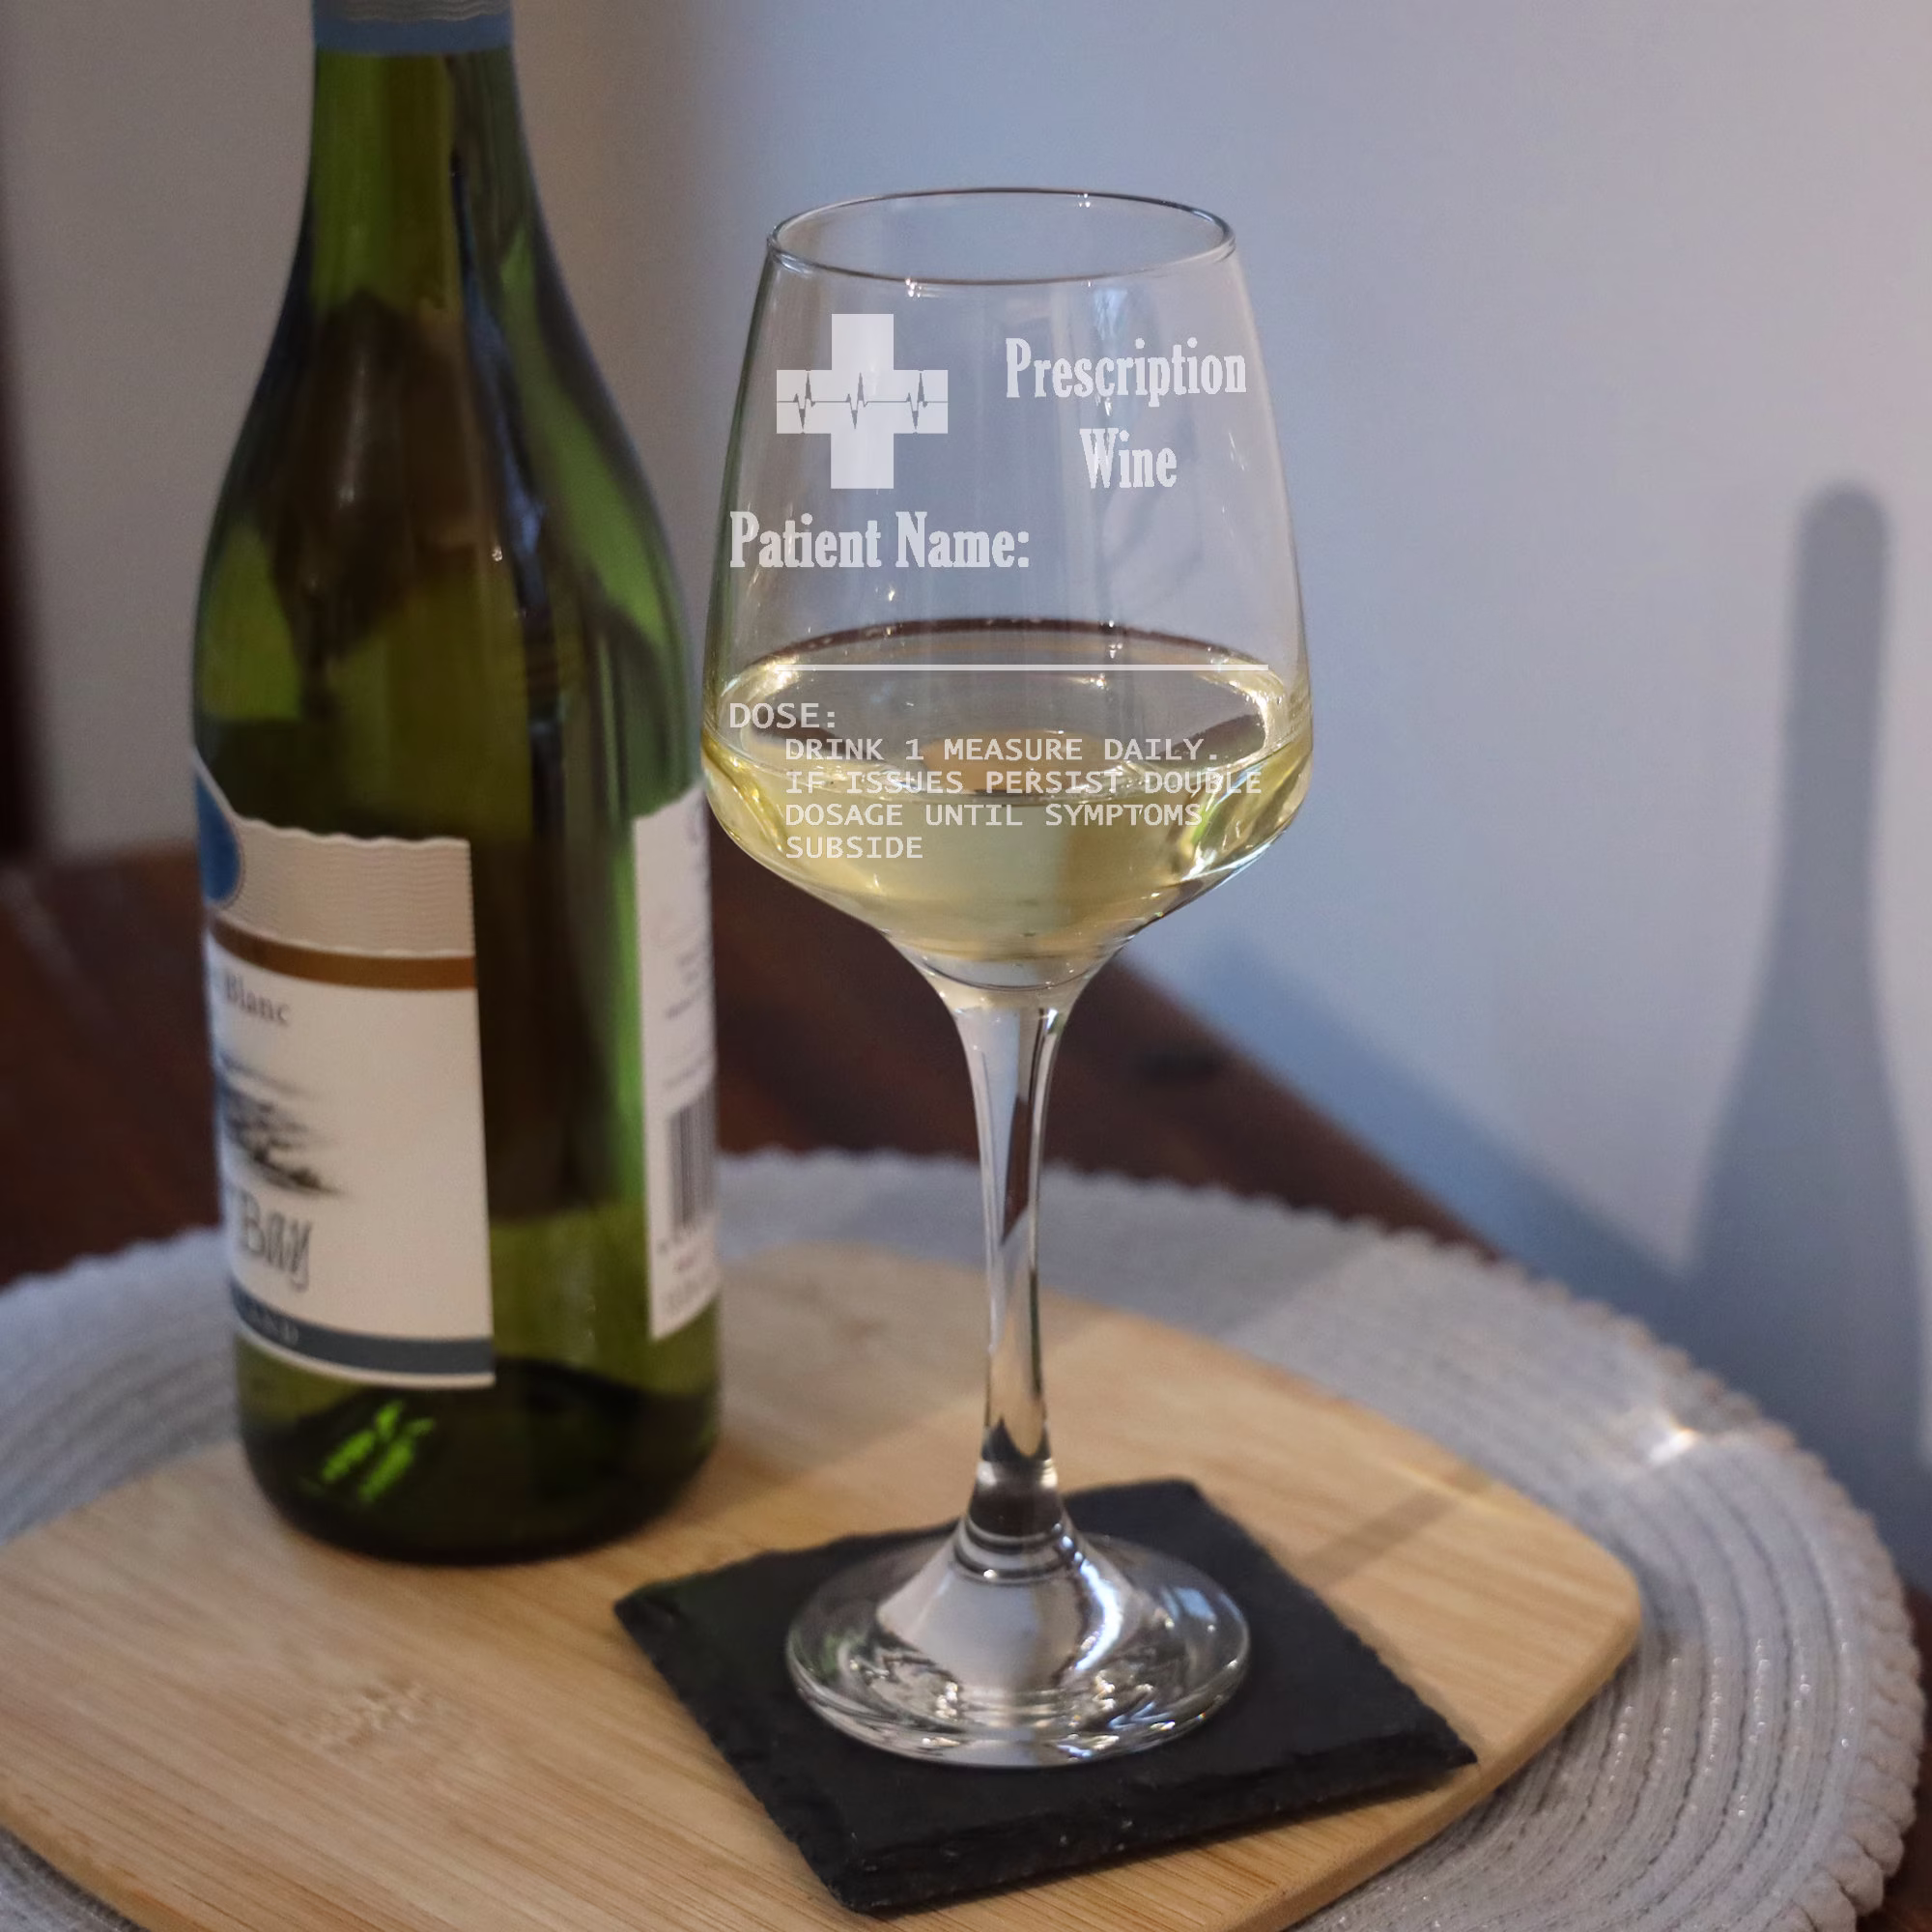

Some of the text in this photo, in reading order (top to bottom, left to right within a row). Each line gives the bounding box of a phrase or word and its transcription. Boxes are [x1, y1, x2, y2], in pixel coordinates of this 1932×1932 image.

[1006, 337, 1247, 408] Prescription
[1080, 428, 1178, 489] Wine
[729, 511, 1030, 568] Patient Name:
[729, 702, 836, 729] DOSE:
[785, 738, 1218, 761] DRINK 1 MEASURE DAILY.
[785, 771, 1263, 794] IF ISSUES PERSIST DOUBLE
[785, 803, 1203, 827] DOSAGE UNTIL SYMPTOMS
[785, 836, 923, 860] SUBSIDE
[223, 970, 290, 1024] Blanc
